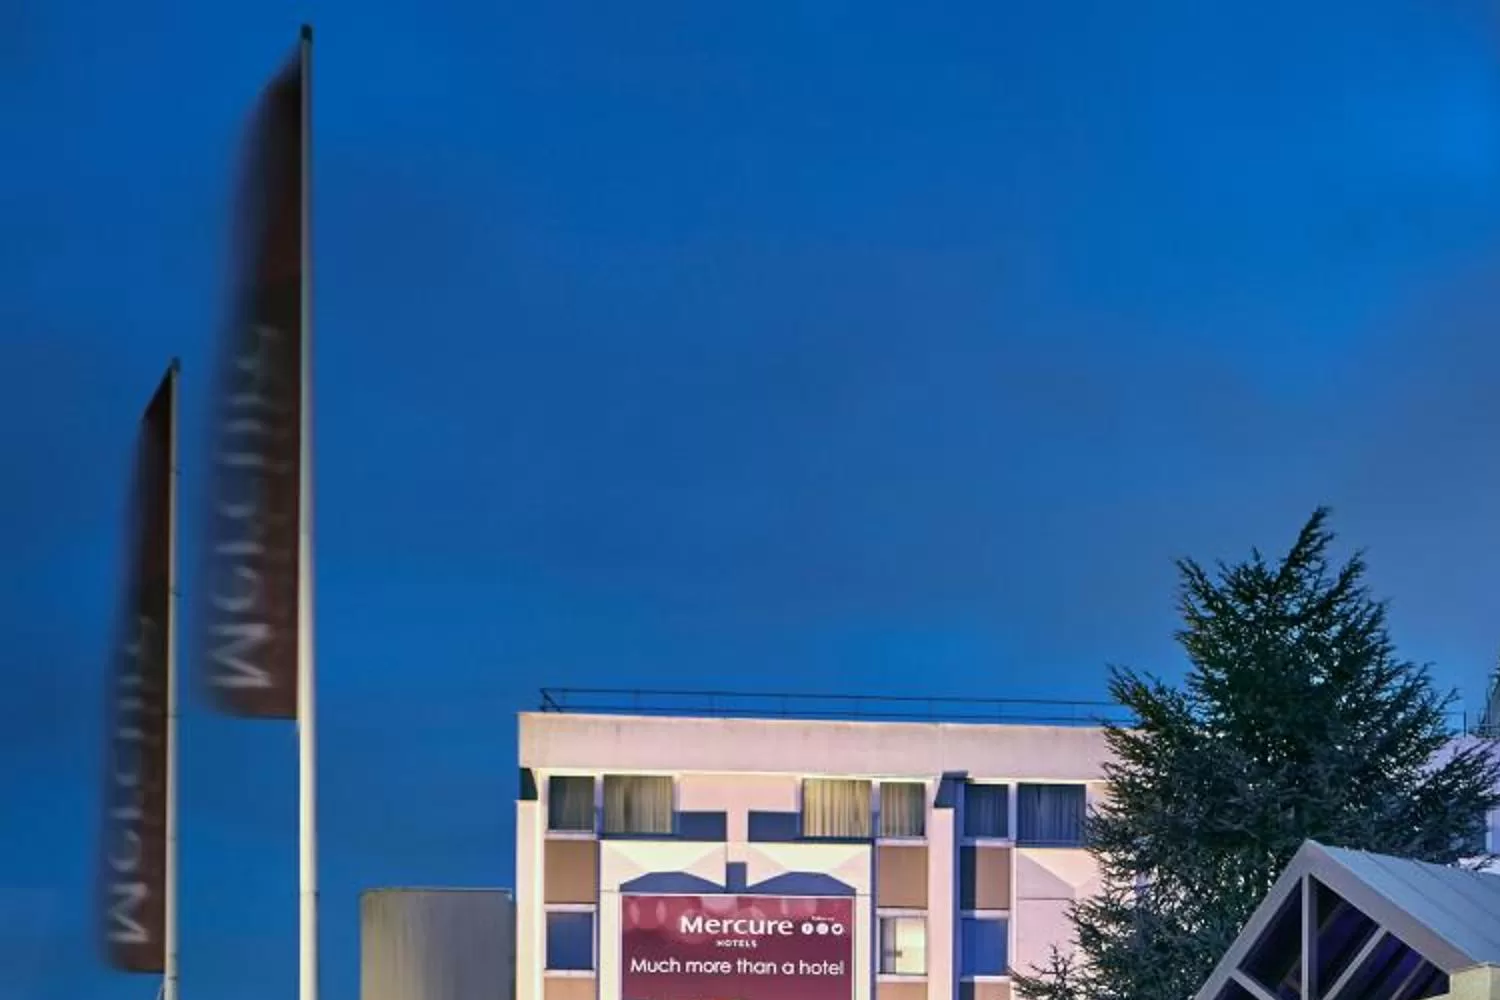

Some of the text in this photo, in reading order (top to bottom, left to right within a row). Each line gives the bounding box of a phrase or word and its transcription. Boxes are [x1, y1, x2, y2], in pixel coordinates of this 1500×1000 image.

[680, 915, 793, 935] Mercure
[716, 939, 757, 948] HOTELS
[630, 957, 845, 976] Much more than a hotel
